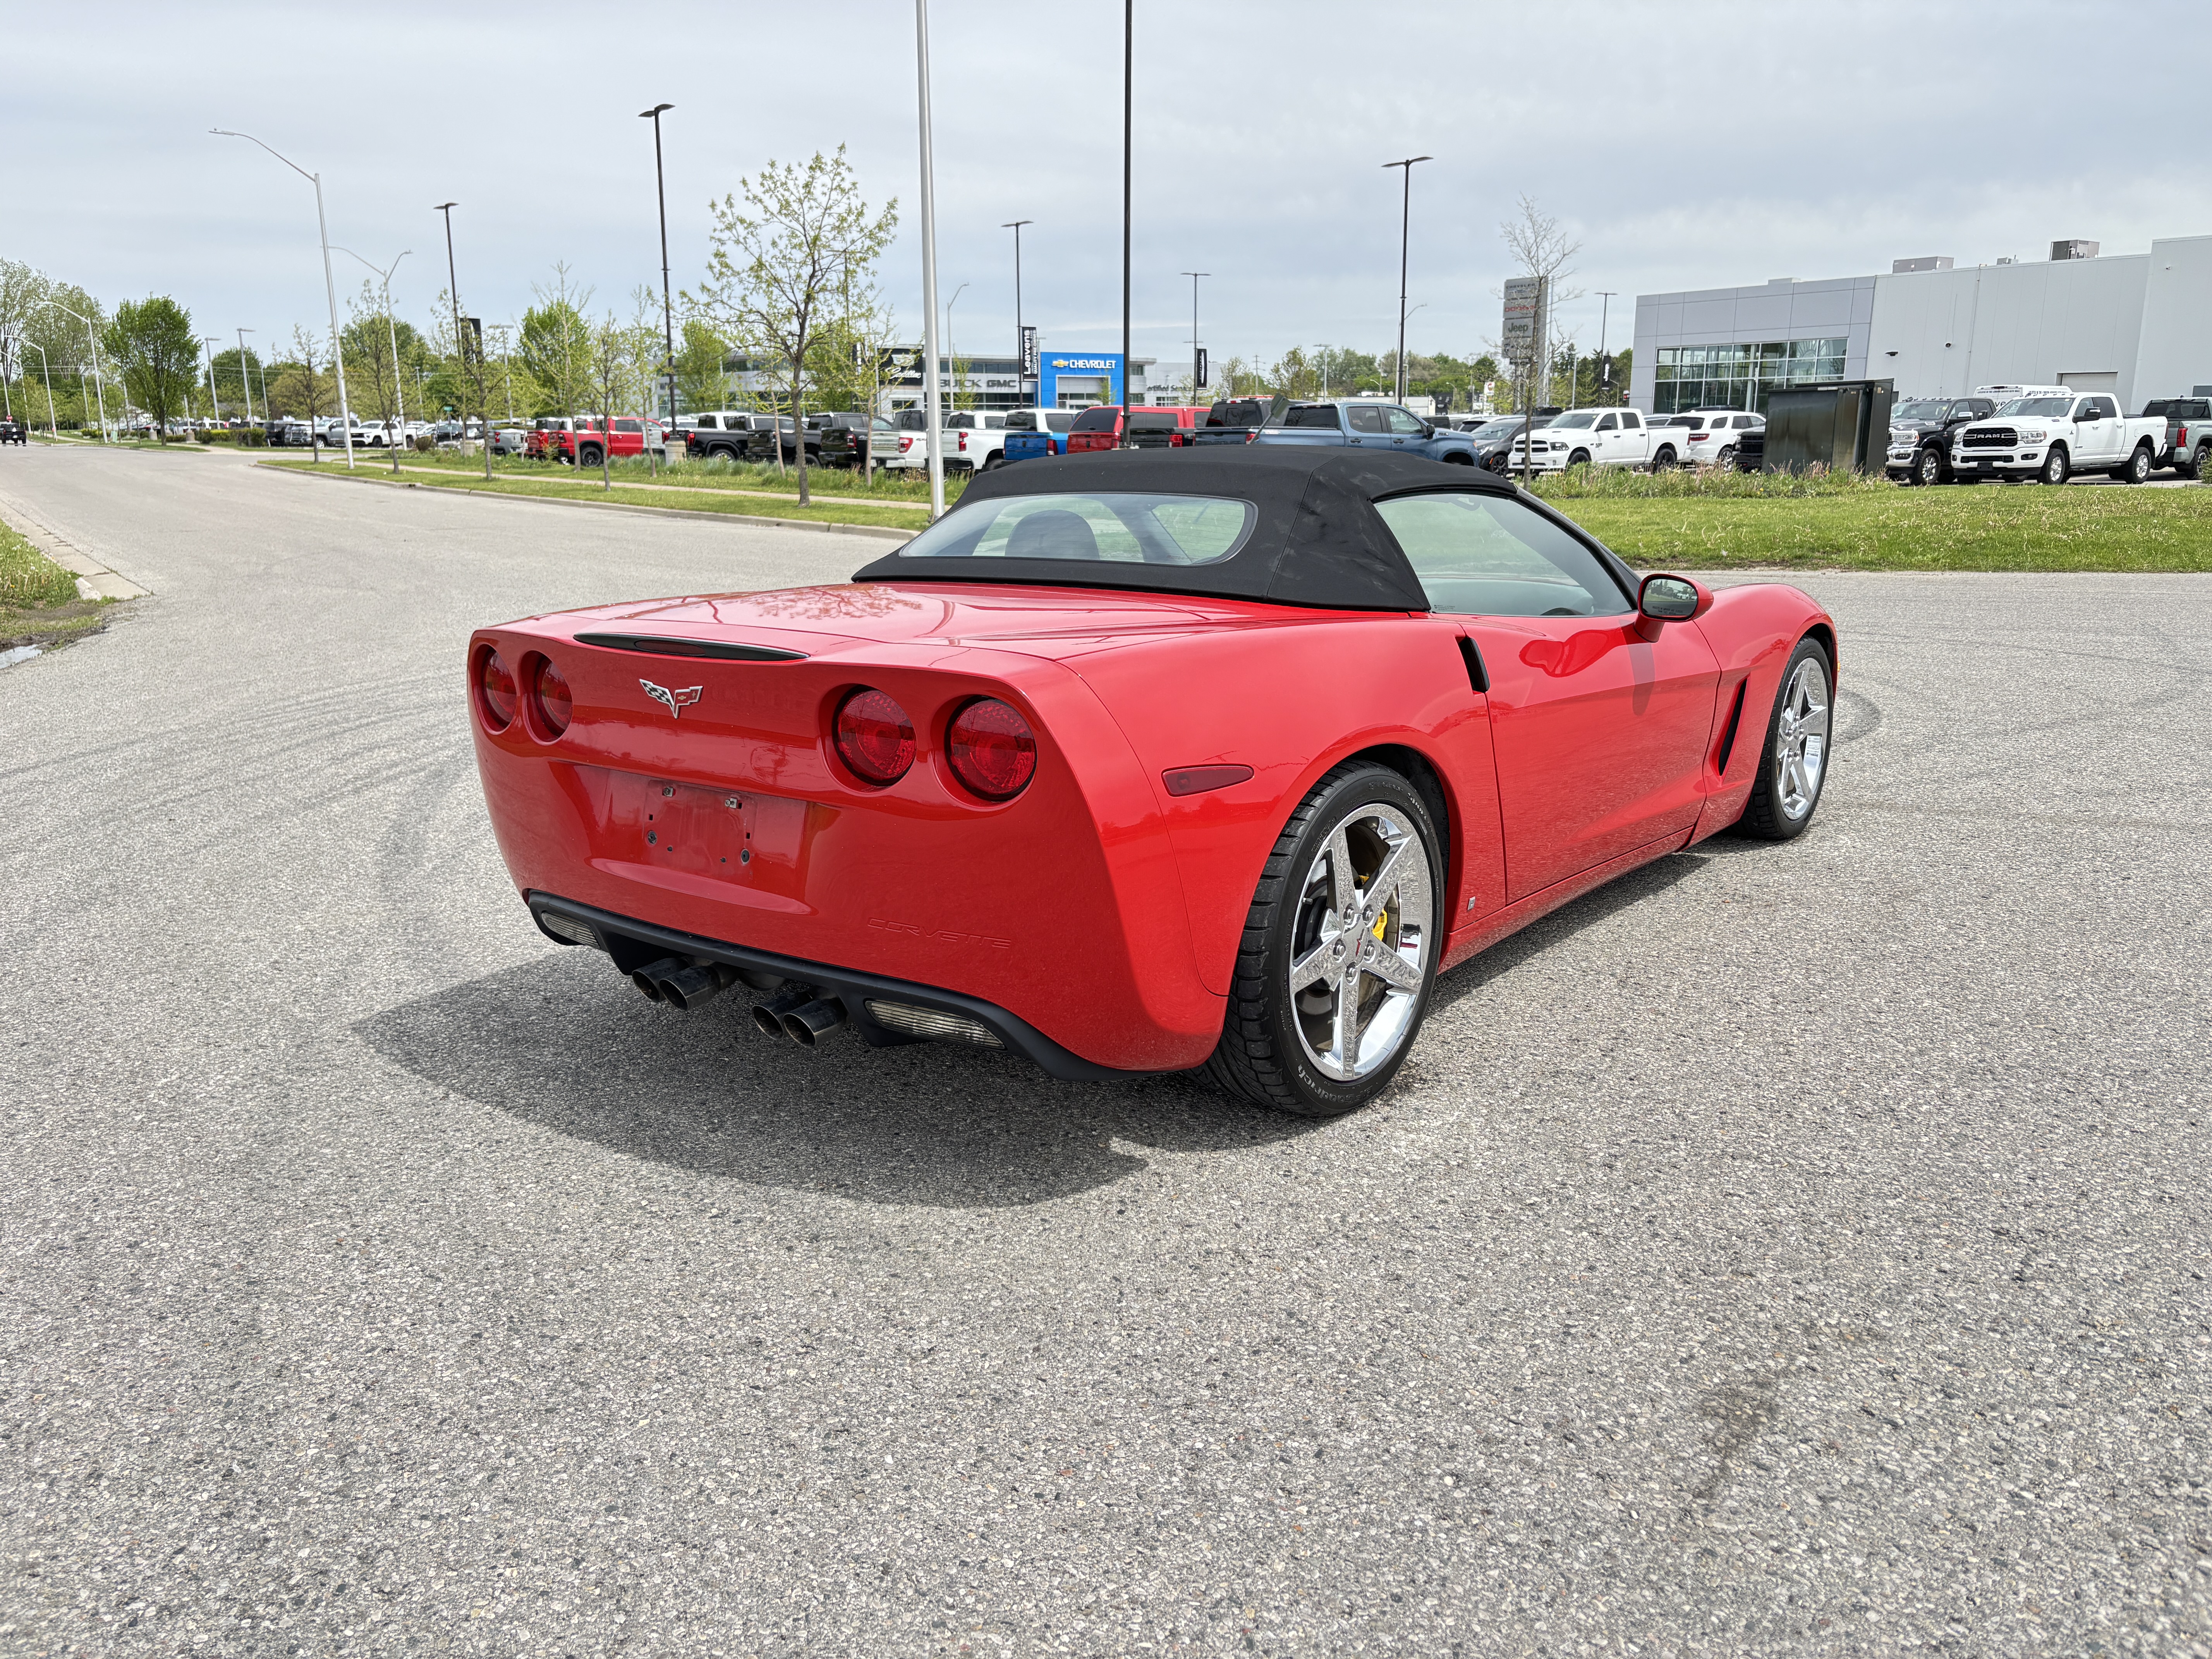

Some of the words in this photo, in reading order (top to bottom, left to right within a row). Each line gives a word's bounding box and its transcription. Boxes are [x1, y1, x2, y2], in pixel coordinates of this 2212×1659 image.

[1508, 322, 1528, 333] Jeep
[1070, 360, 1116, 369] CHEVROLET
[885, 367, 921, 379] Cadillac
[867, 917, 1012, 948] CORVETTE
[1298, 1064, 1373, 1104] BFGoodrich
